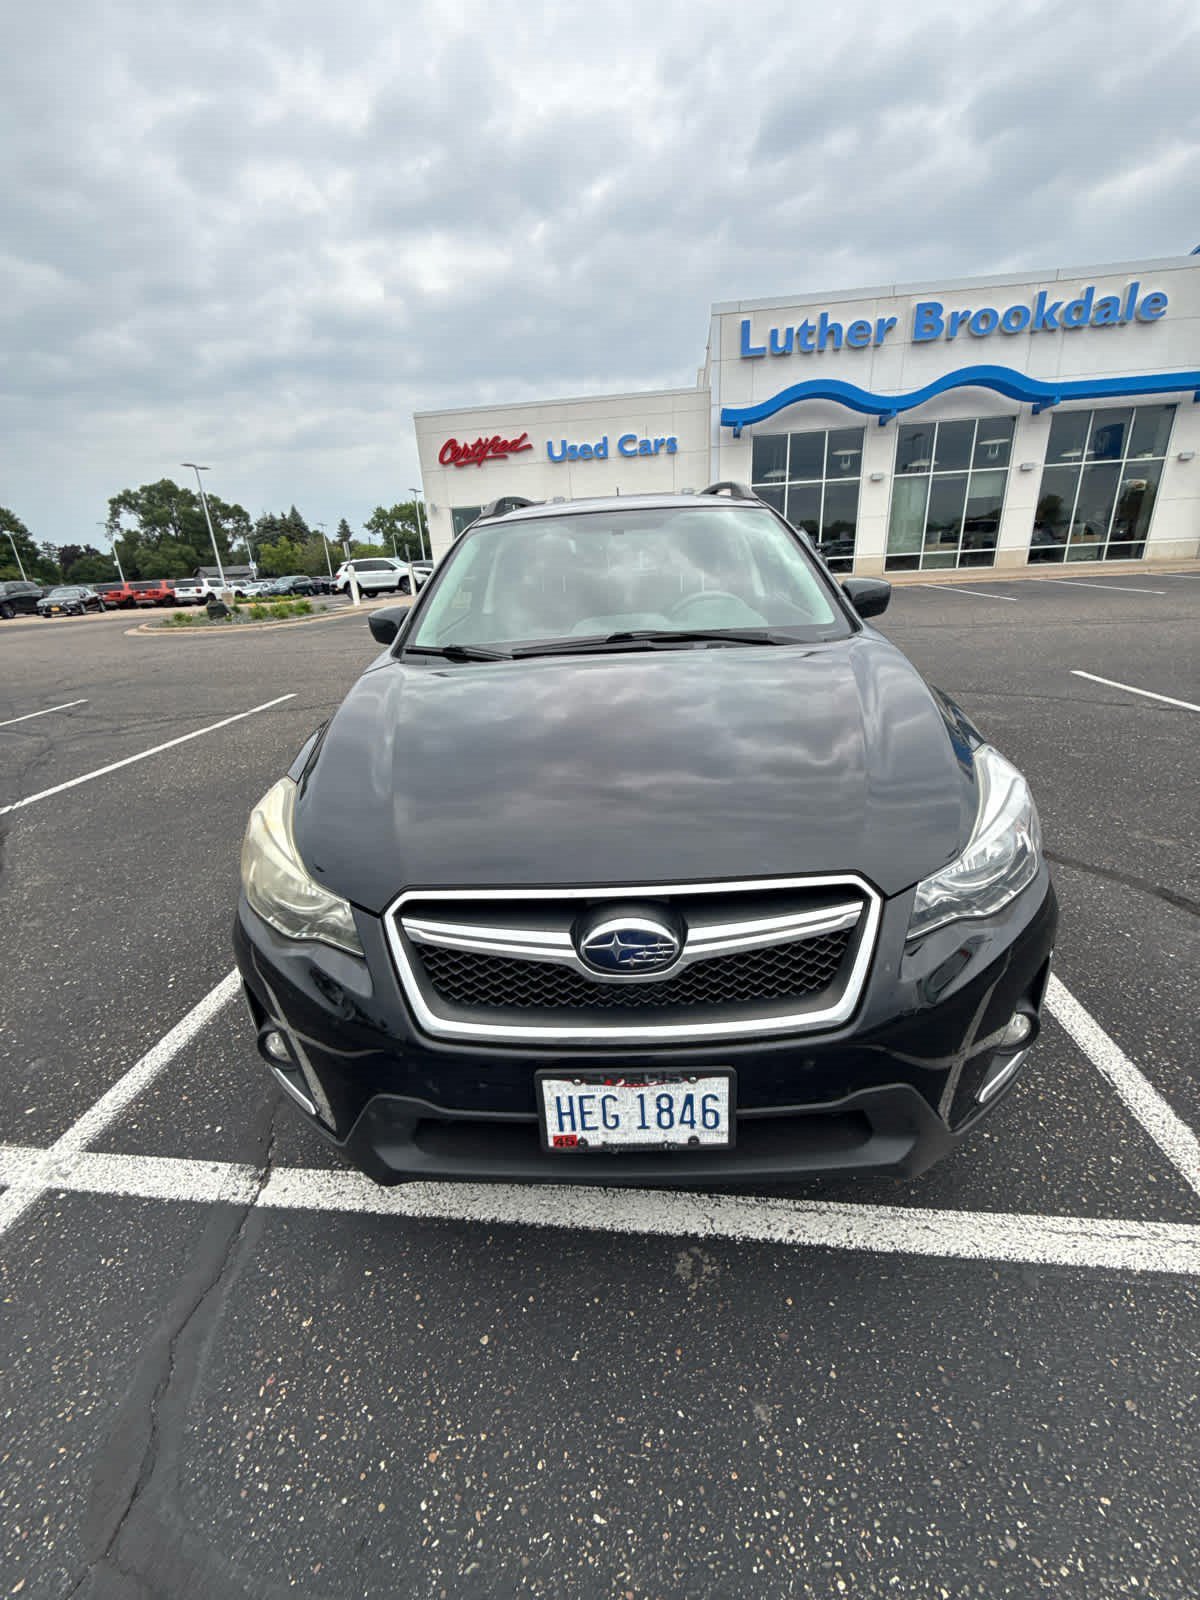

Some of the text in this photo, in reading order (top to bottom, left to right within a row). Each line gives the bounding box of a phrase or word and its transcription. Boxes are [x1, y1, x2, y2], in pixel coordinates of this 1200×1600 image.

[740, 281, 1169, 358] Luther Brookdale
[438, 433, 678, 467] Certified Used Cars
[555, 1093, 721, 1133] HEG 1846
